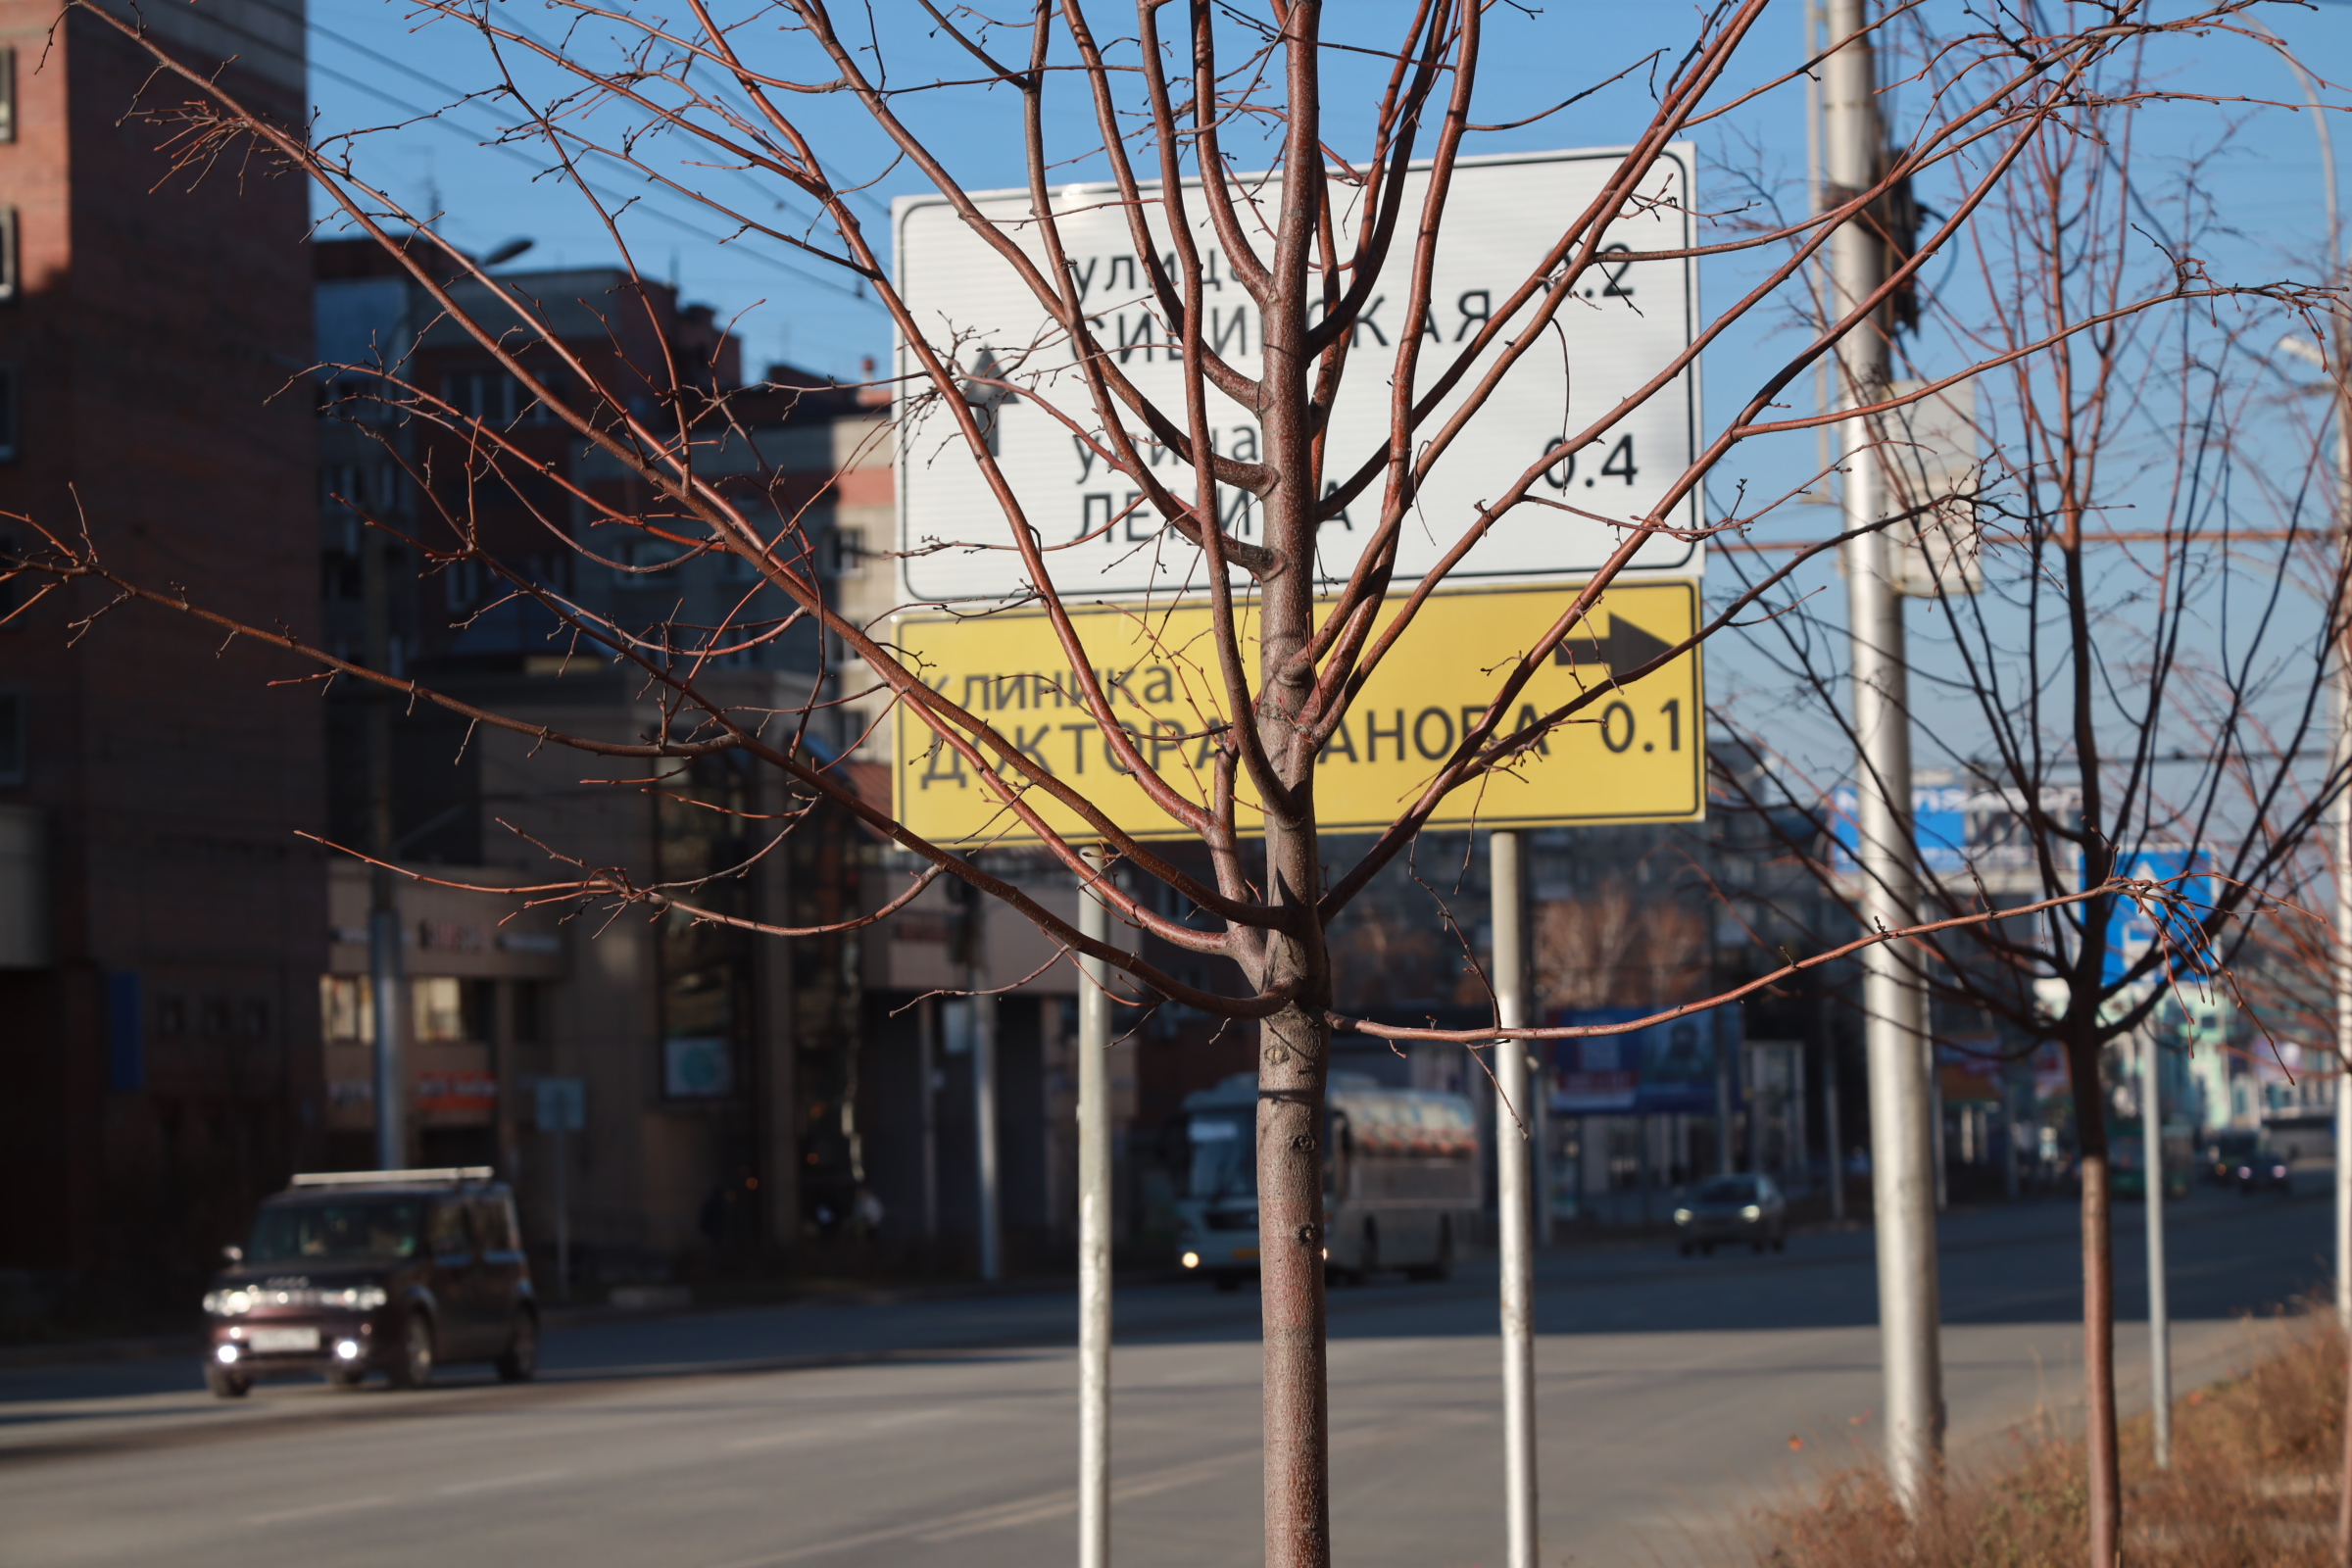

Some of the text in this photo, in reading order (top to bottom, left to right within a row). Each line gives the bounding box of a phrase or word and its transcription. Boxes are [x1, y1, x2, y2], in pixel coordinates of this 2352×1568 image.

[1072, 247, 1243, 307] улиц
[1070, 289, 1492, 366] СИИКАЯ
[1070, 422, 1259, 484] уиа
[1543, 433, 1639, 489] 0.4
[1074, 478, 1353, 544] ЛЕИА
[1315, 703, 1550, 764] АНОВА
[1601, 698, 1680, 754] 0.1
